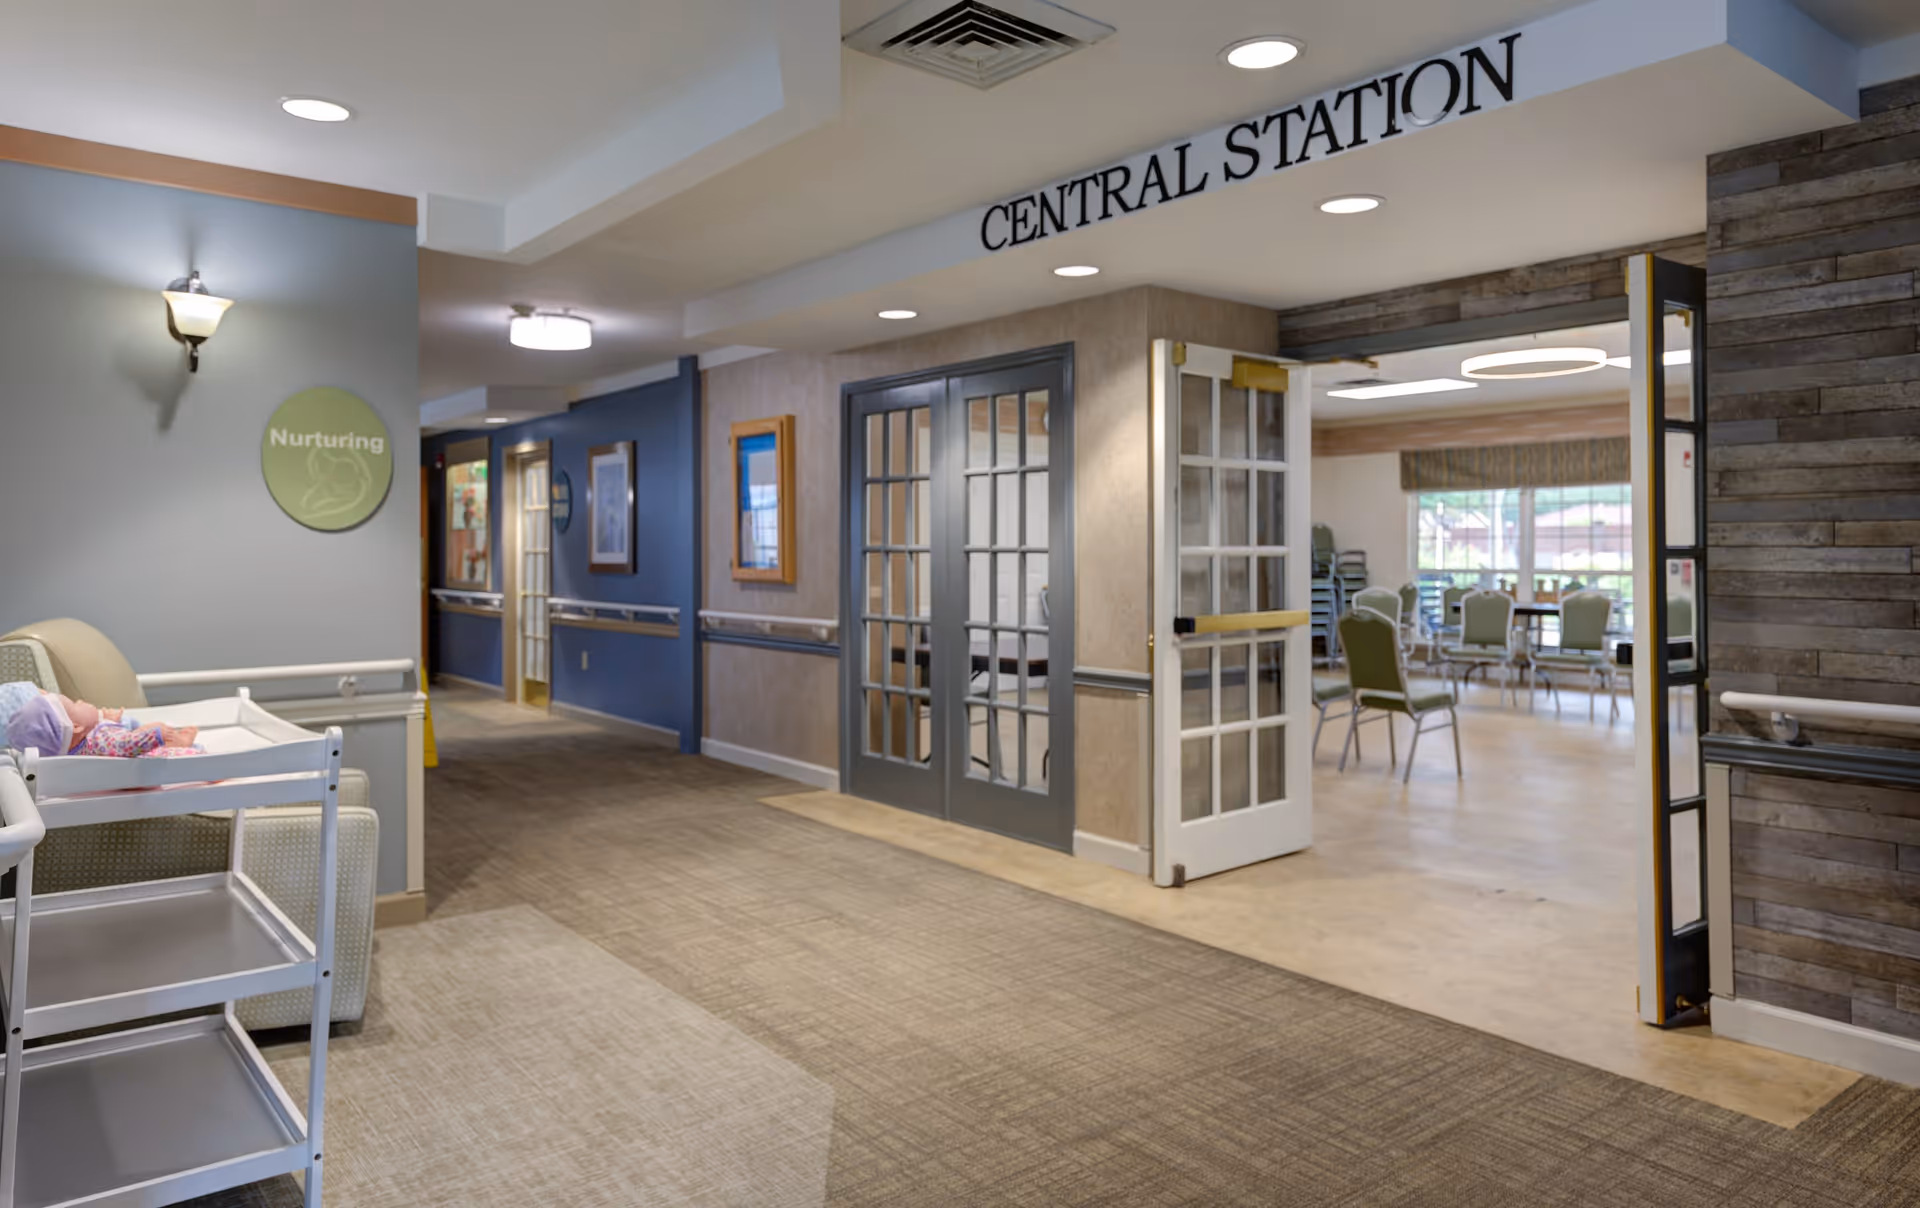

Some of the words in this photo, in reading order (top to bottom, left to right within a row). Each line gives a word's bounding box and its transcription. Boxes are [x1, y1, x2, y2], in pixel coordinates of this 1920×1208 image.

[981, 143, 1208, 251] CENTRAL
[1223, 33, 1522, 183] STATION
[270, 427, 384, 454] Nurturing
